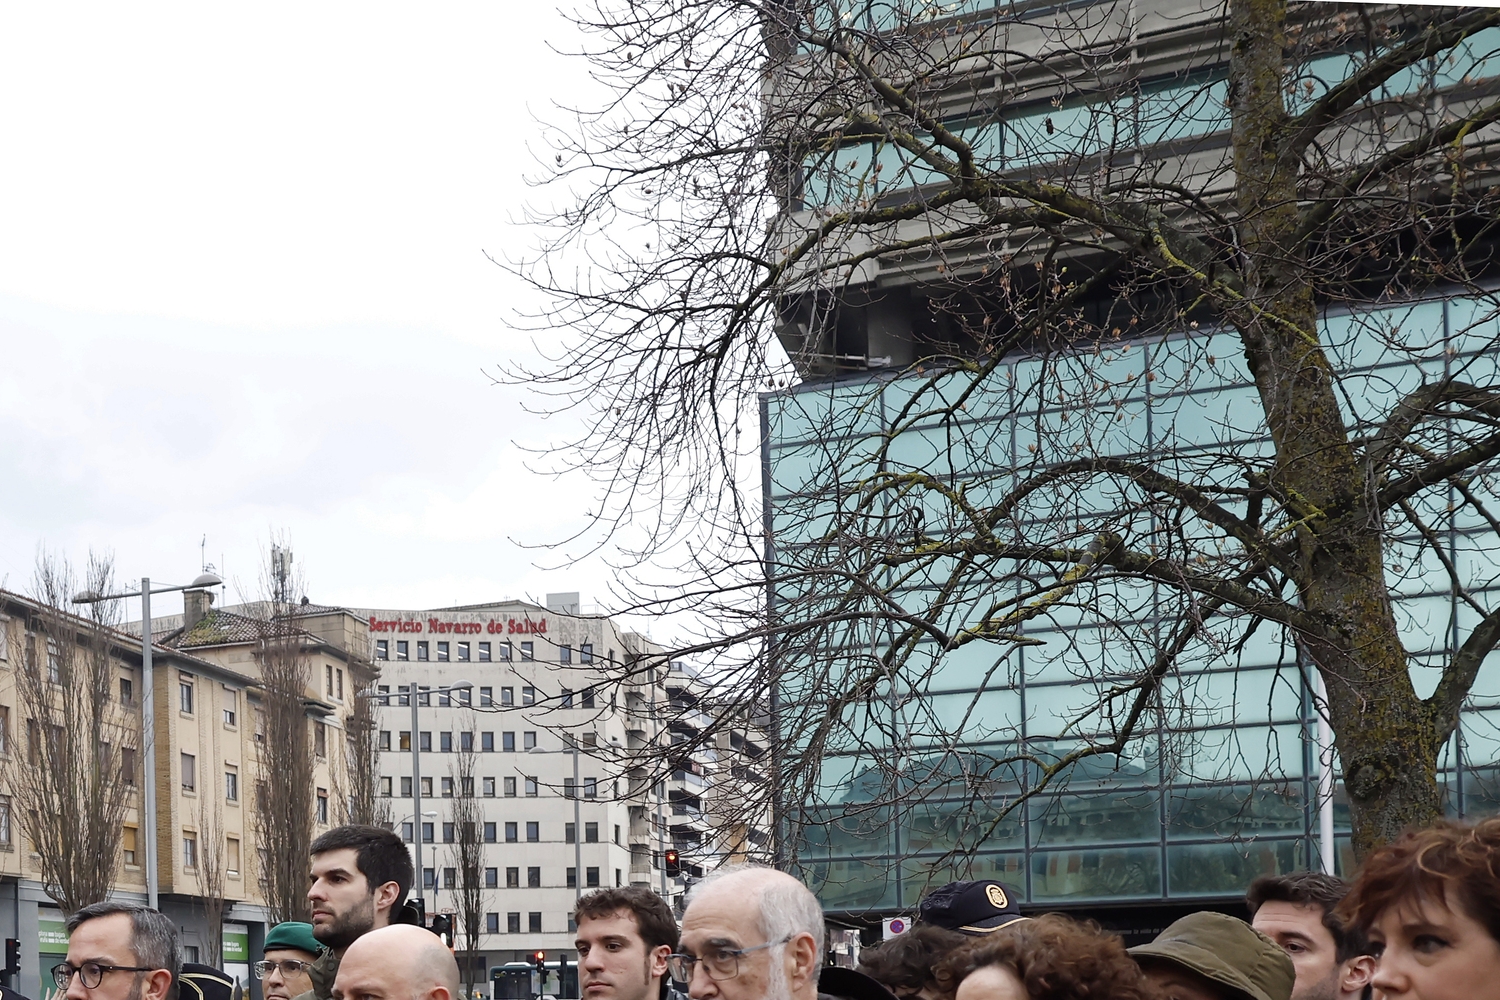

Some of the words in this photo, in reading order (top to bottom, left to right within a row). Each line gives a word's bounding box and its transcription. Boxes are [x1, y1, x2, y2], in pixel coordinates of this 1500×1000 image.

[369, 616, 423, 633] Servicio
[428, 618, 482, 634] Navarro
[487, 619, 503, 634] de
[508, 618, 547, 634] Salud
